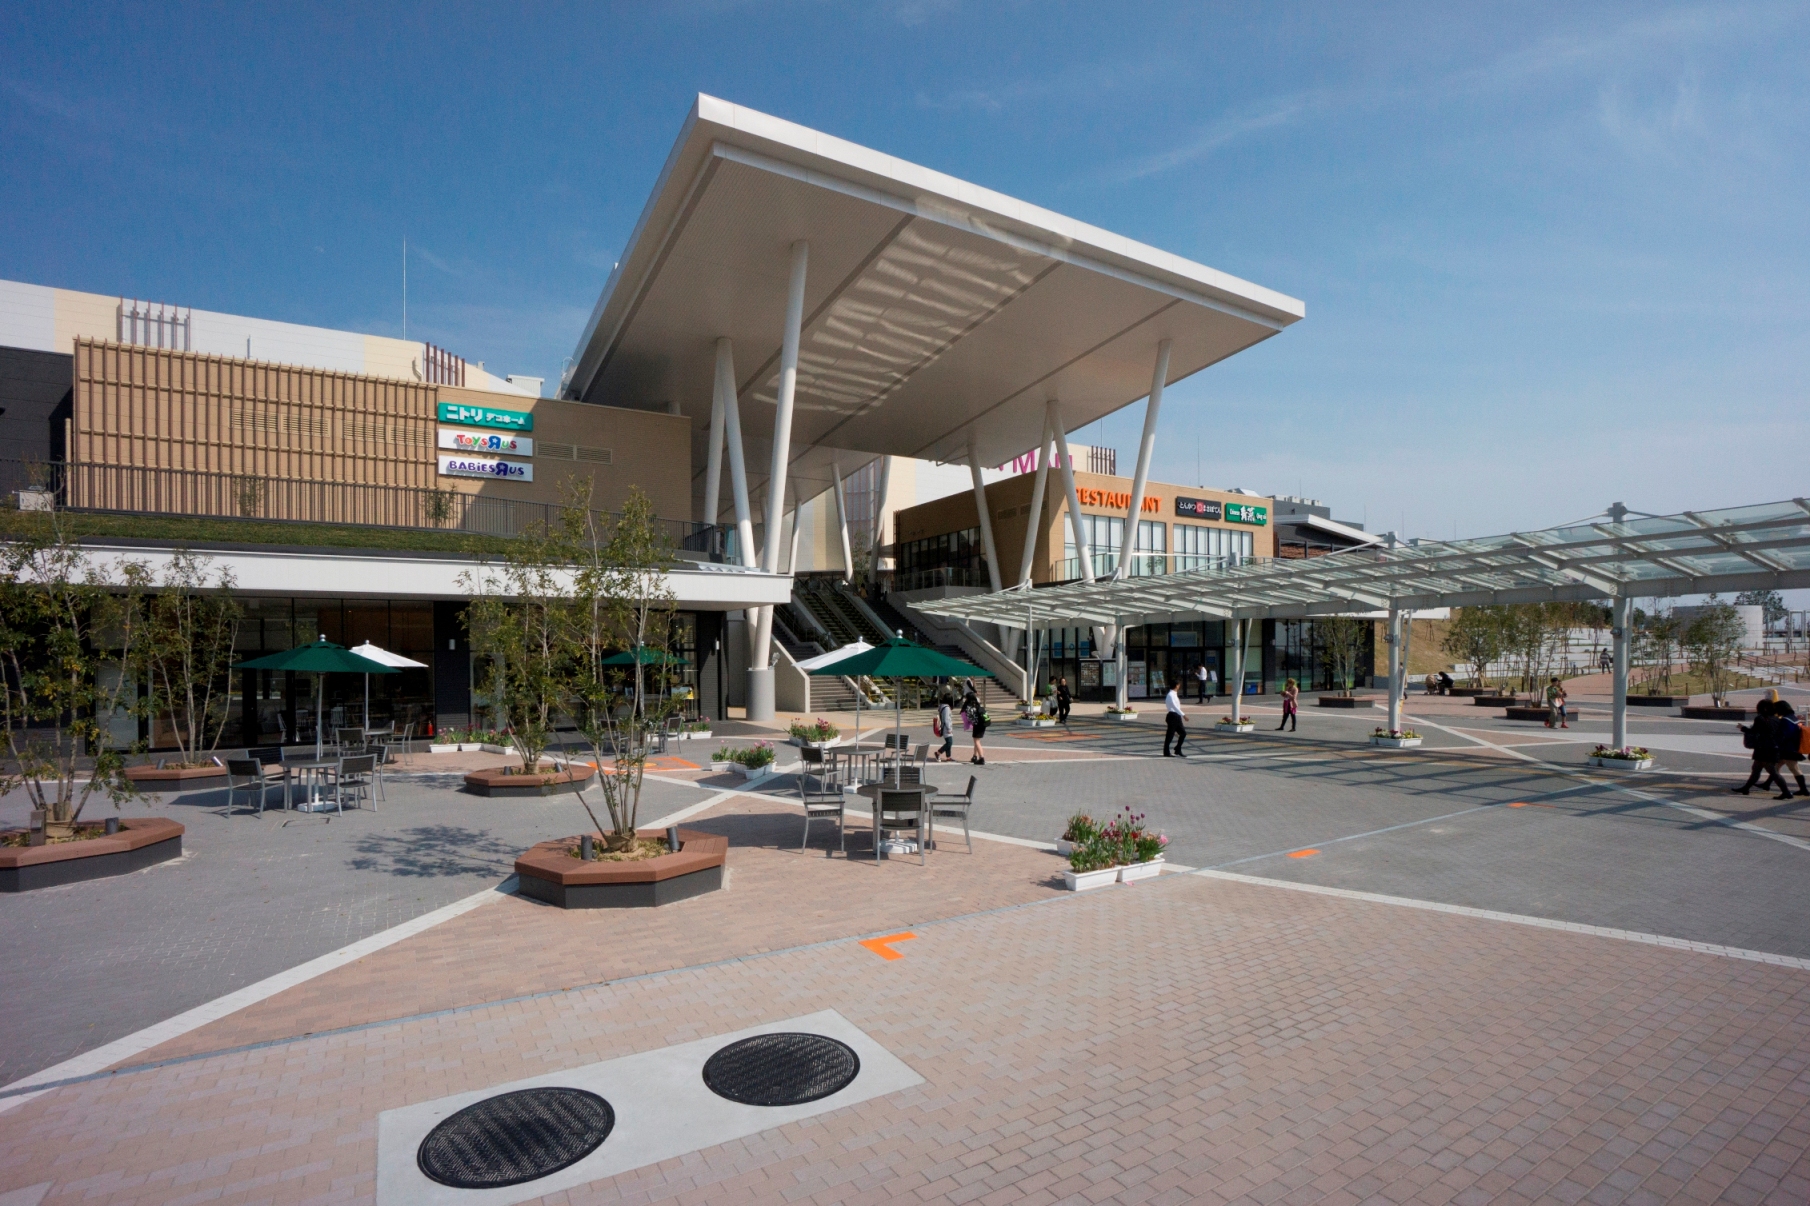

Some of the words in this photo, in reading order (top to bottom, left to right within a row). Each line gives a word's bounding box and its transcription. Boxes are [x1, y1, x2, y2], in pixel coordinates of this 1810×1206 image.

[446, 405, 483, 422] ニトリ
[486, 412, 525, 425] デコホーム
